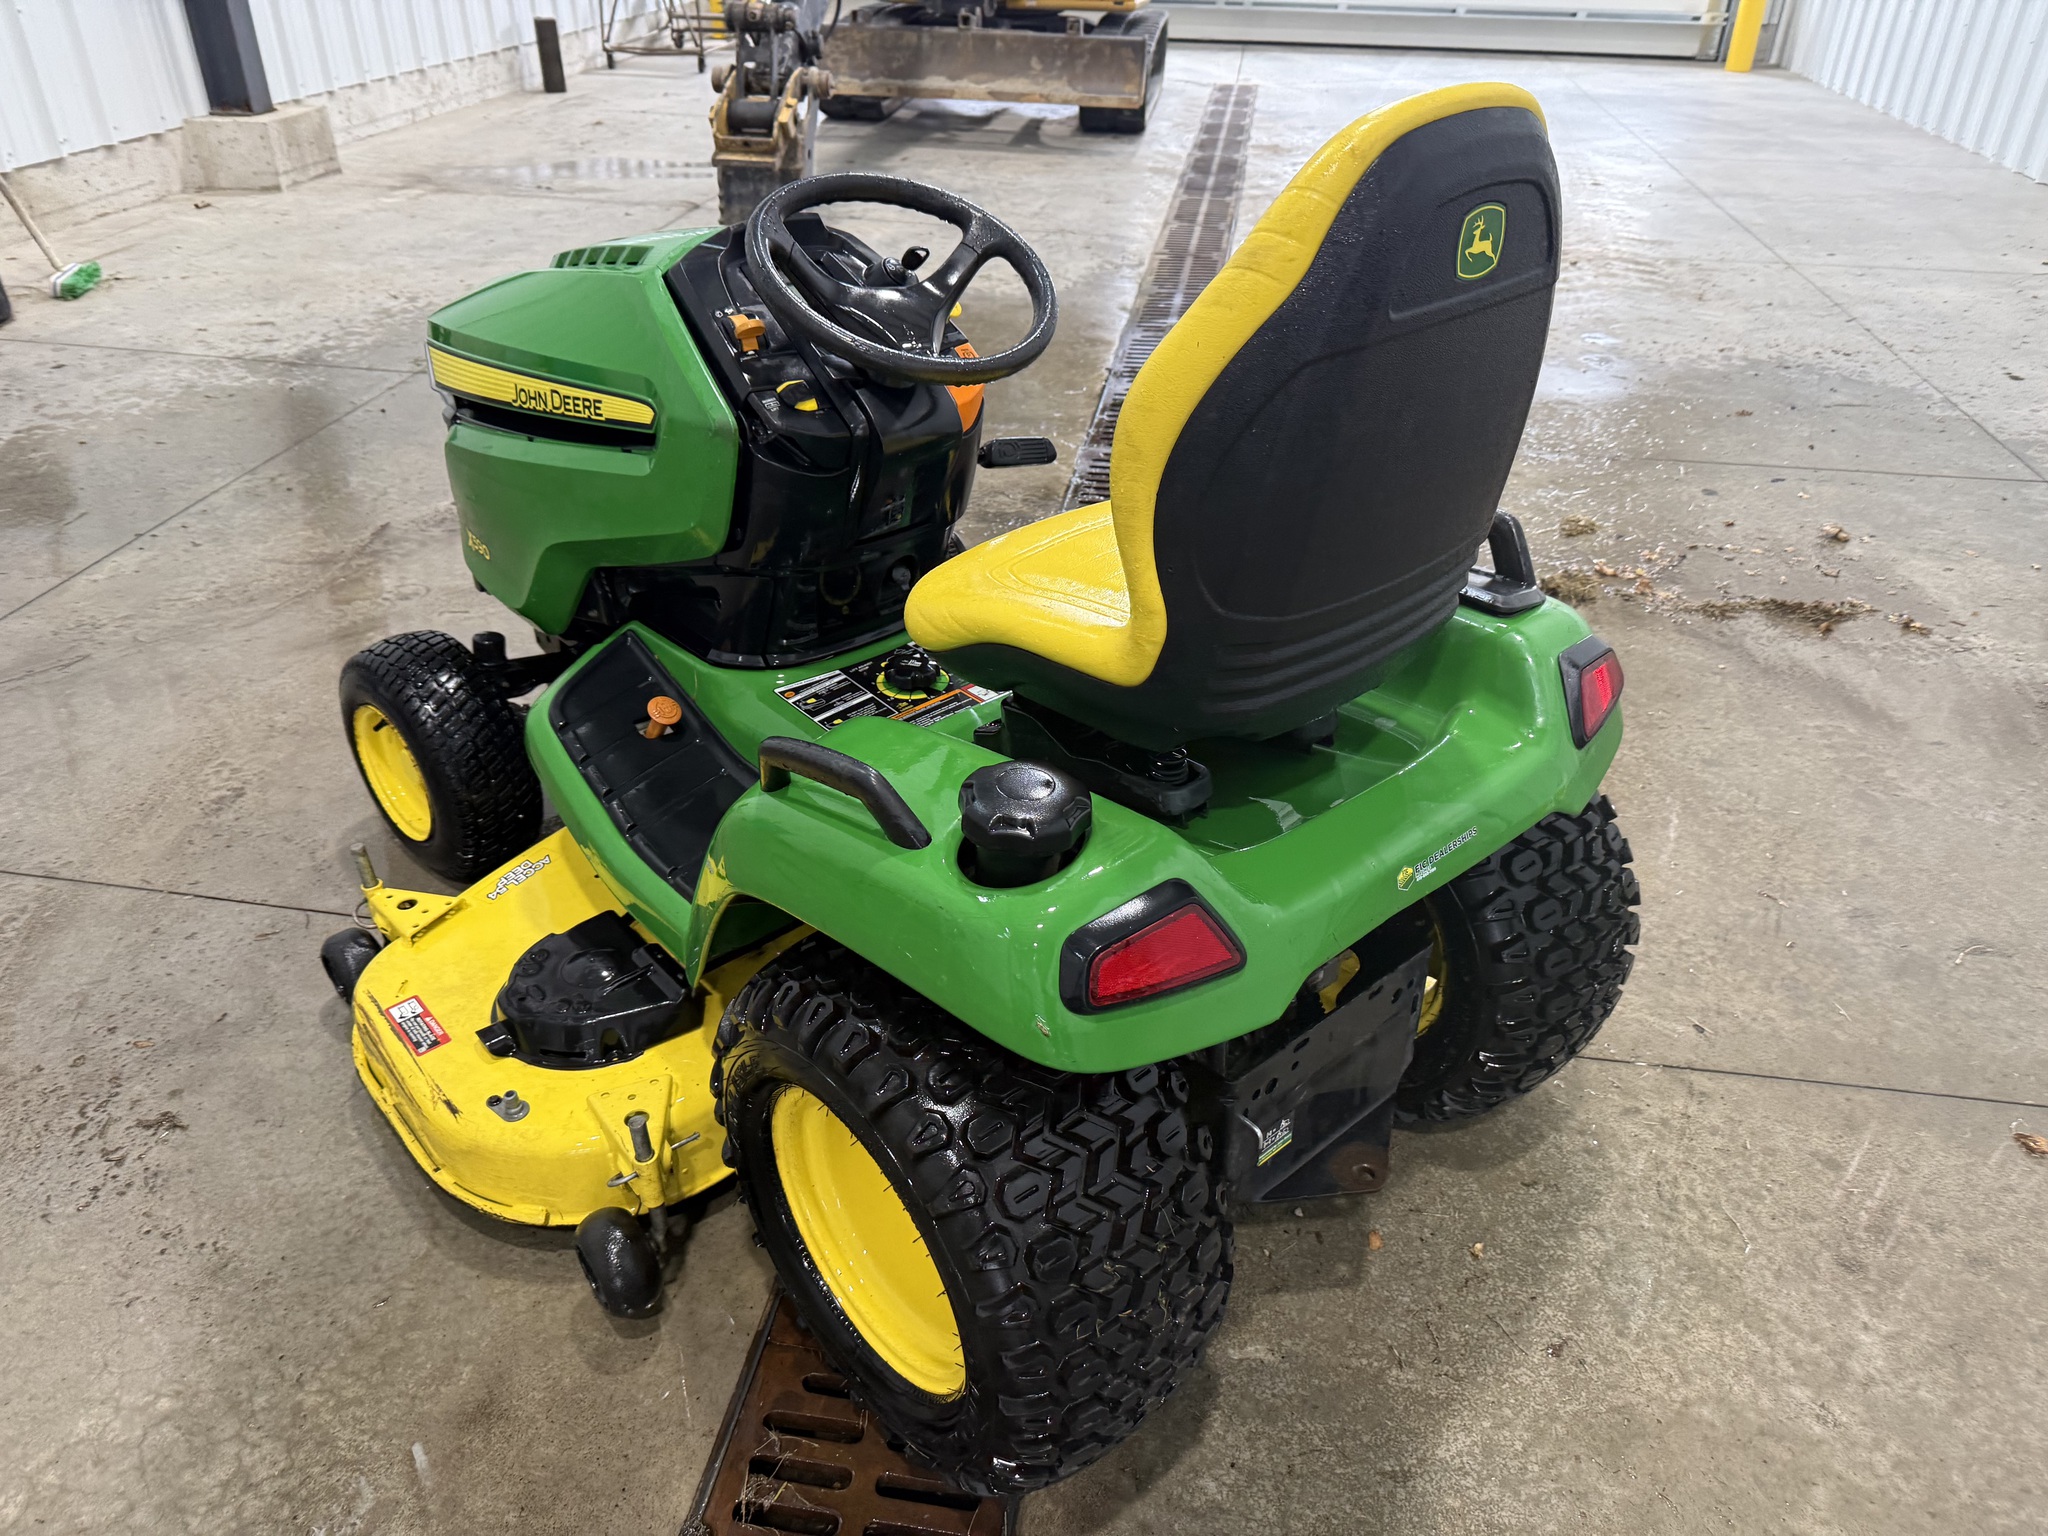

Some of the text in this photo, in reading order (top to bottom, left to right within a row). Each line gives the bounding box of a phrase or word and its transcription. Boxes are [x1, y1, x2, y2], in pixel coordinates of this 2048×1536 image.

[511, 384, 604, 417] JOHN DEERE
[1428, 826, 1478, 864] DEALERSHIPS
[487, 854, 551, 900] ACCEL 54
[497, 859, 533, 887] DEEP
